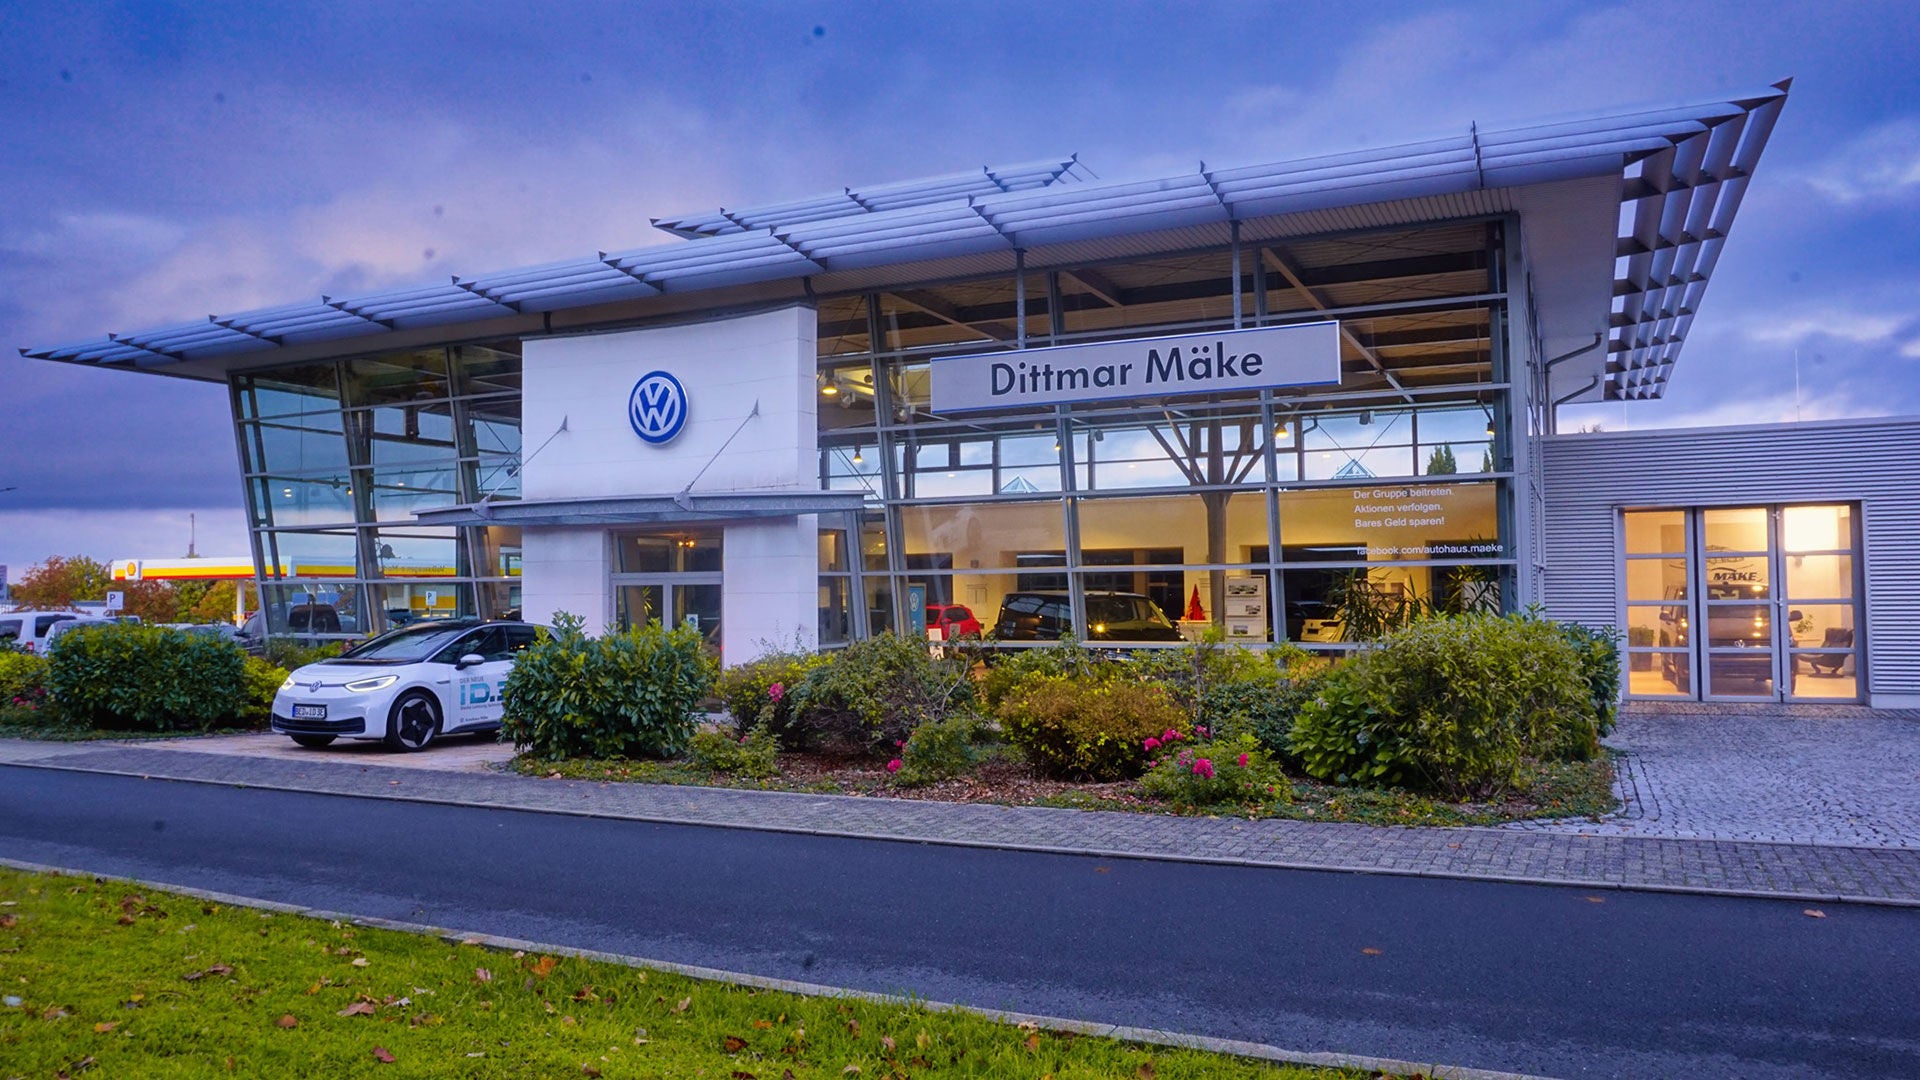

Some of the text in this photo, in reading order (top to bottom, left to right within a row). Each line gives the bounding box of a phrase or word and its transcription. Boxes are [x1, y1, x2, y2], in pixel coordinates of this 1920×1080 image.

[991, 341, 1263, 396] Dittmar Mäke
[631, 376, 682, 438] VW
[1353, 487, 1455, 500] Der Gruppe beitreten.
[1354, 502, 1444, 513] Aktionen verfolgen.
[1354, 516, 1445, 528] Bares Geld sparen!
[1356, 543, 1504, 555] facebook.com/autohaus.maeke
[109, 593, 116, 603] P
